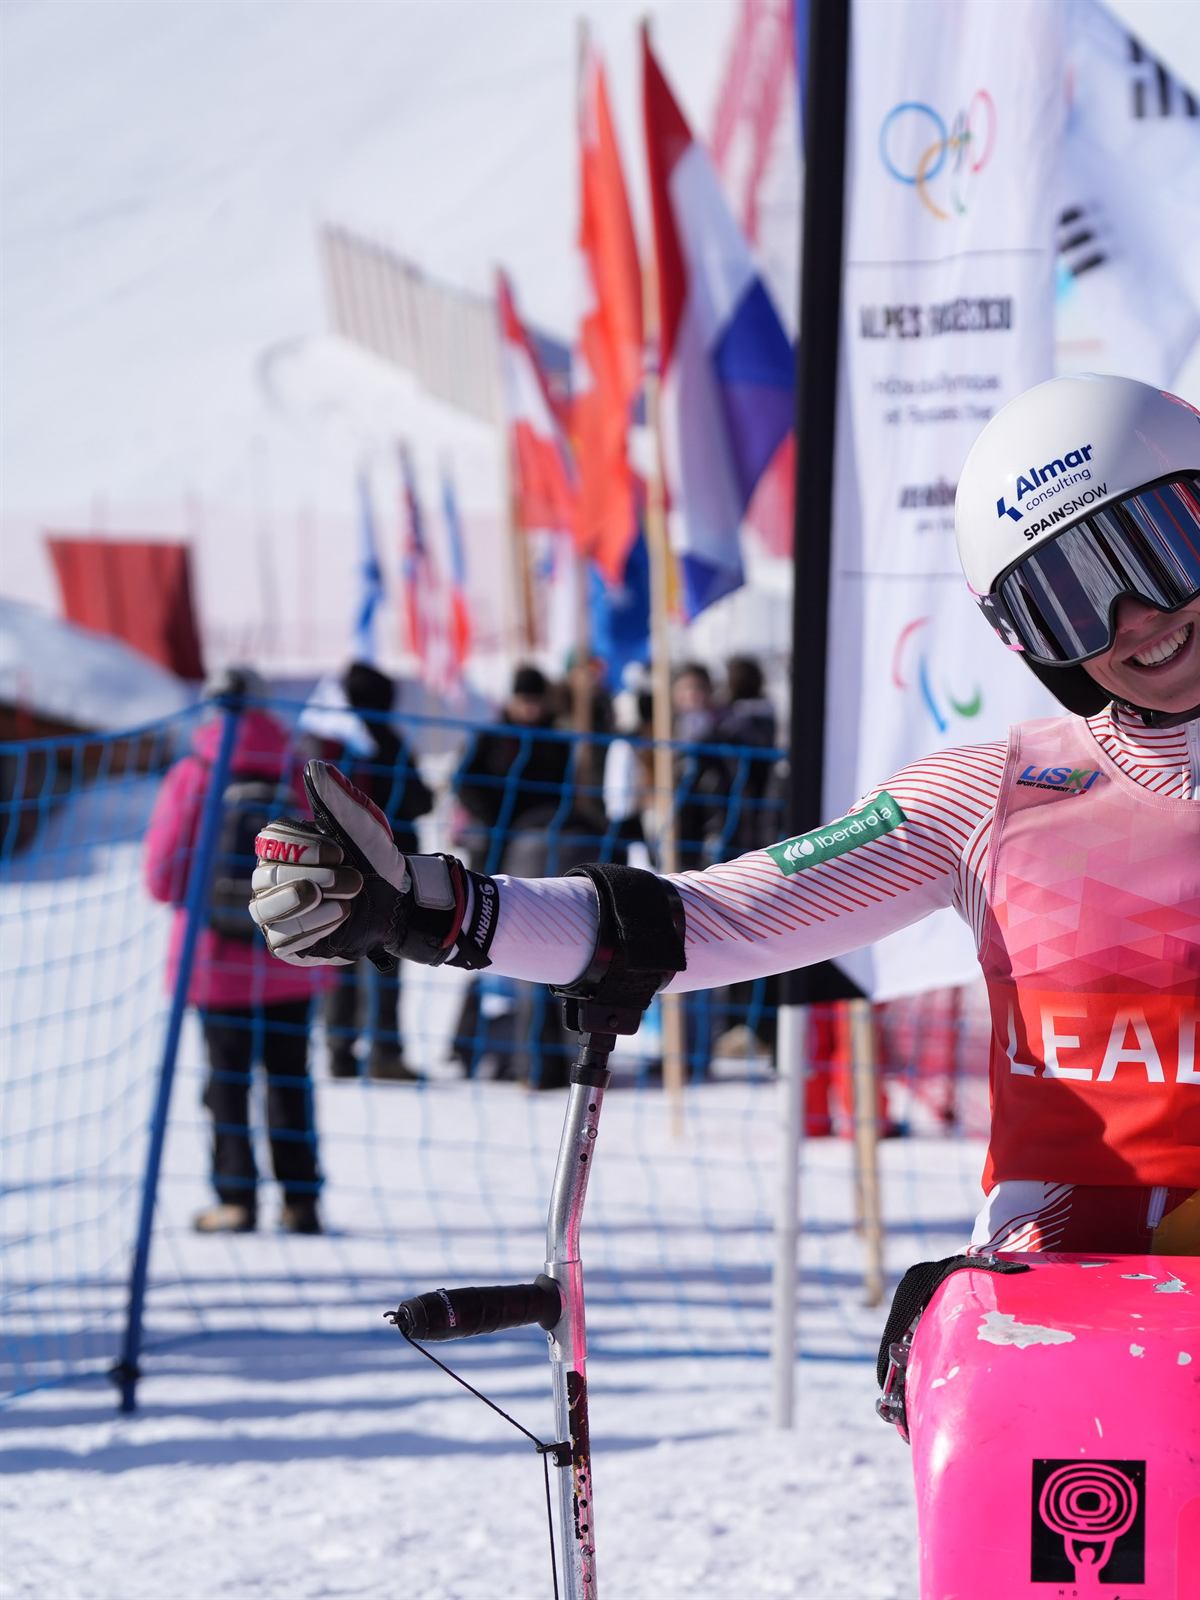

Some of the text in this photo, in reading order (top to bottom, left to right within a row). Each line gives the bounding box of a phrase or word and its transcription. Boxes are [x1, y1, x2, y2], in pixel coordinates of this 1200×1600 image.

[1016, 444, 1092, 501] Almar
[1026, 469, 1092, 511] consulting
[1023, 482, 1108, 541] SPAINSNOW
[1020, 765, 1101, 790] LISKI
[814, 807, 893, 849] Iberdrola
[255, 836, 311, 864] WANY
[474, 896, 493, 949] SWANY
